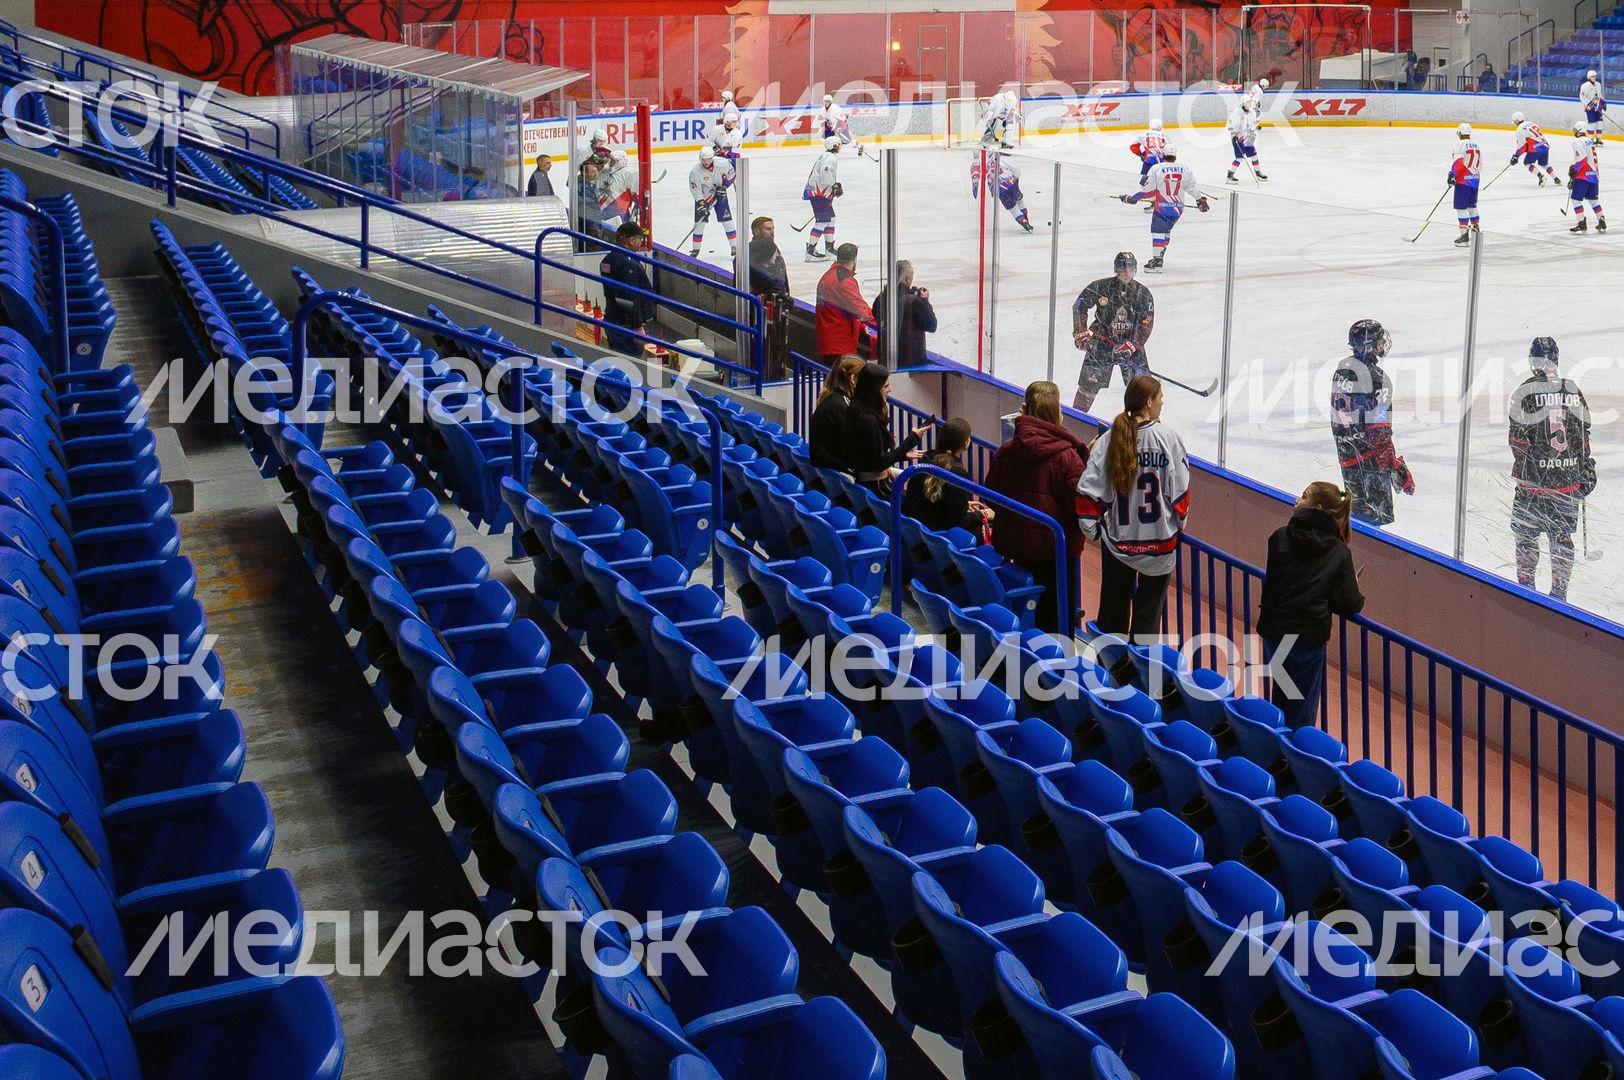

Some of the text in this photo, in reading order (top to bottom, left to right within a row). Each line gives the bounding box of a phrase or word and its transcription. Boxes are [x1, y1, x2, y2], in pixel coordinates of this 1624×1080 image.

[1062, 102, 1121, 118] X17
[1291, 99, 1368, 116] X17
[1164, 174, 1183, 196] 17
[1549, 409, 1568, 452] 5
[27, 975, 42, 1002] 3
